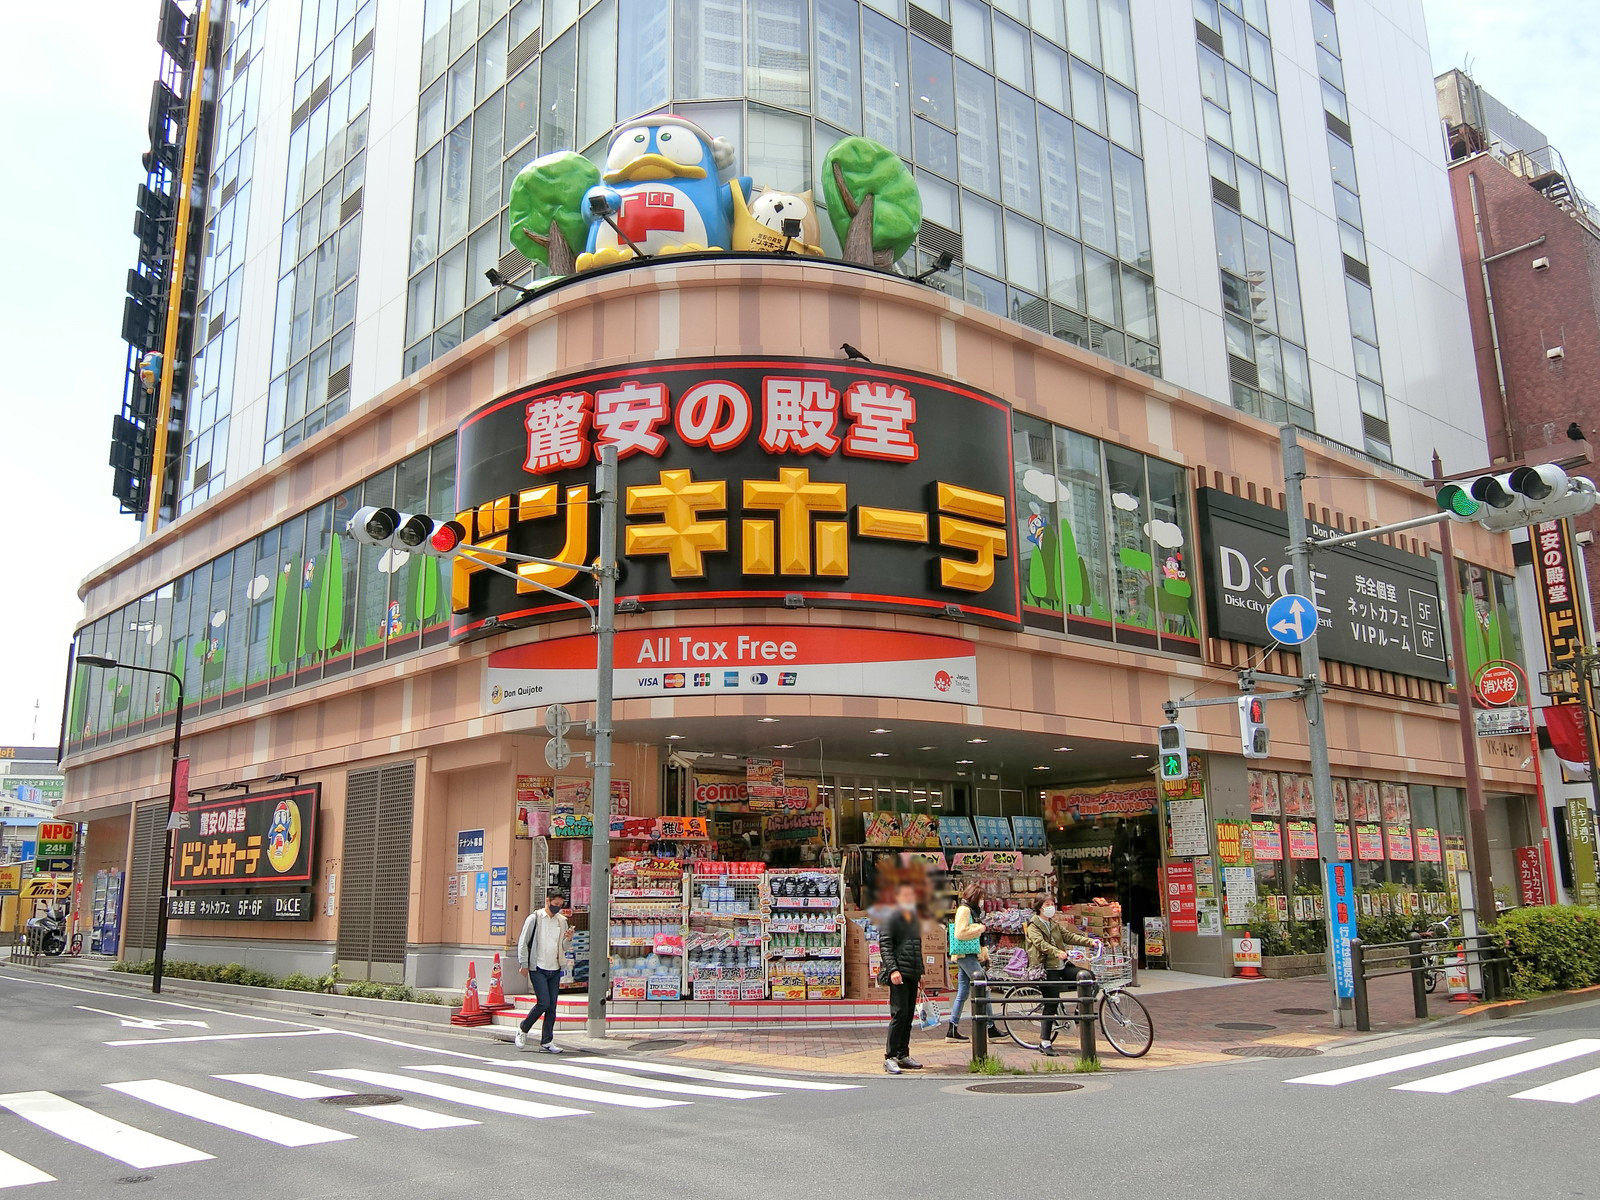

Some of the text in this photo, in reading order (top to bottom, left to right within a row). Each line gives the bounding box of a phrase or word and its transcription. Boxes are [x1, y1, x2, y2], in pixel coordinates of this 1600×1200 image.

[522, 375, 919, 476] 驚安の殿堂
[1312, 524, 1329, 540] Don
[1354, 574, 1398, 604] 完全個室
[1225, 594, 1246, 609] Disk
[1246, 599, 1266, 616] City
[1347, 597, 1409, 628] ネットカフェ
[1418, 602, 1432, 622] 5F
[1350, 621, 1411, 652] VIPルーム
[1421, 630, 1435, 649] 6F
[637, 634, 798, 663] All Tax Free
[638, 676, 659, 687] VISA
[1482, 676, 1516, 695] 消火栓
[504, 685, 543, 699] Don Quijote
[42, 824, 73, 840] NPC
[1217, 824, 1239, 840] FLOOR
[1577, 800, 1589, 845] トキワ通り
[45, 844, 67, 852] 24H
[1219, 841, 1240, 857] GUIDE
[1527, 849, 1543, 904] ネットカフェ
[172, 901, 196, 915] 完全個室
[200, 900, 230, 914] ネットカフェ
